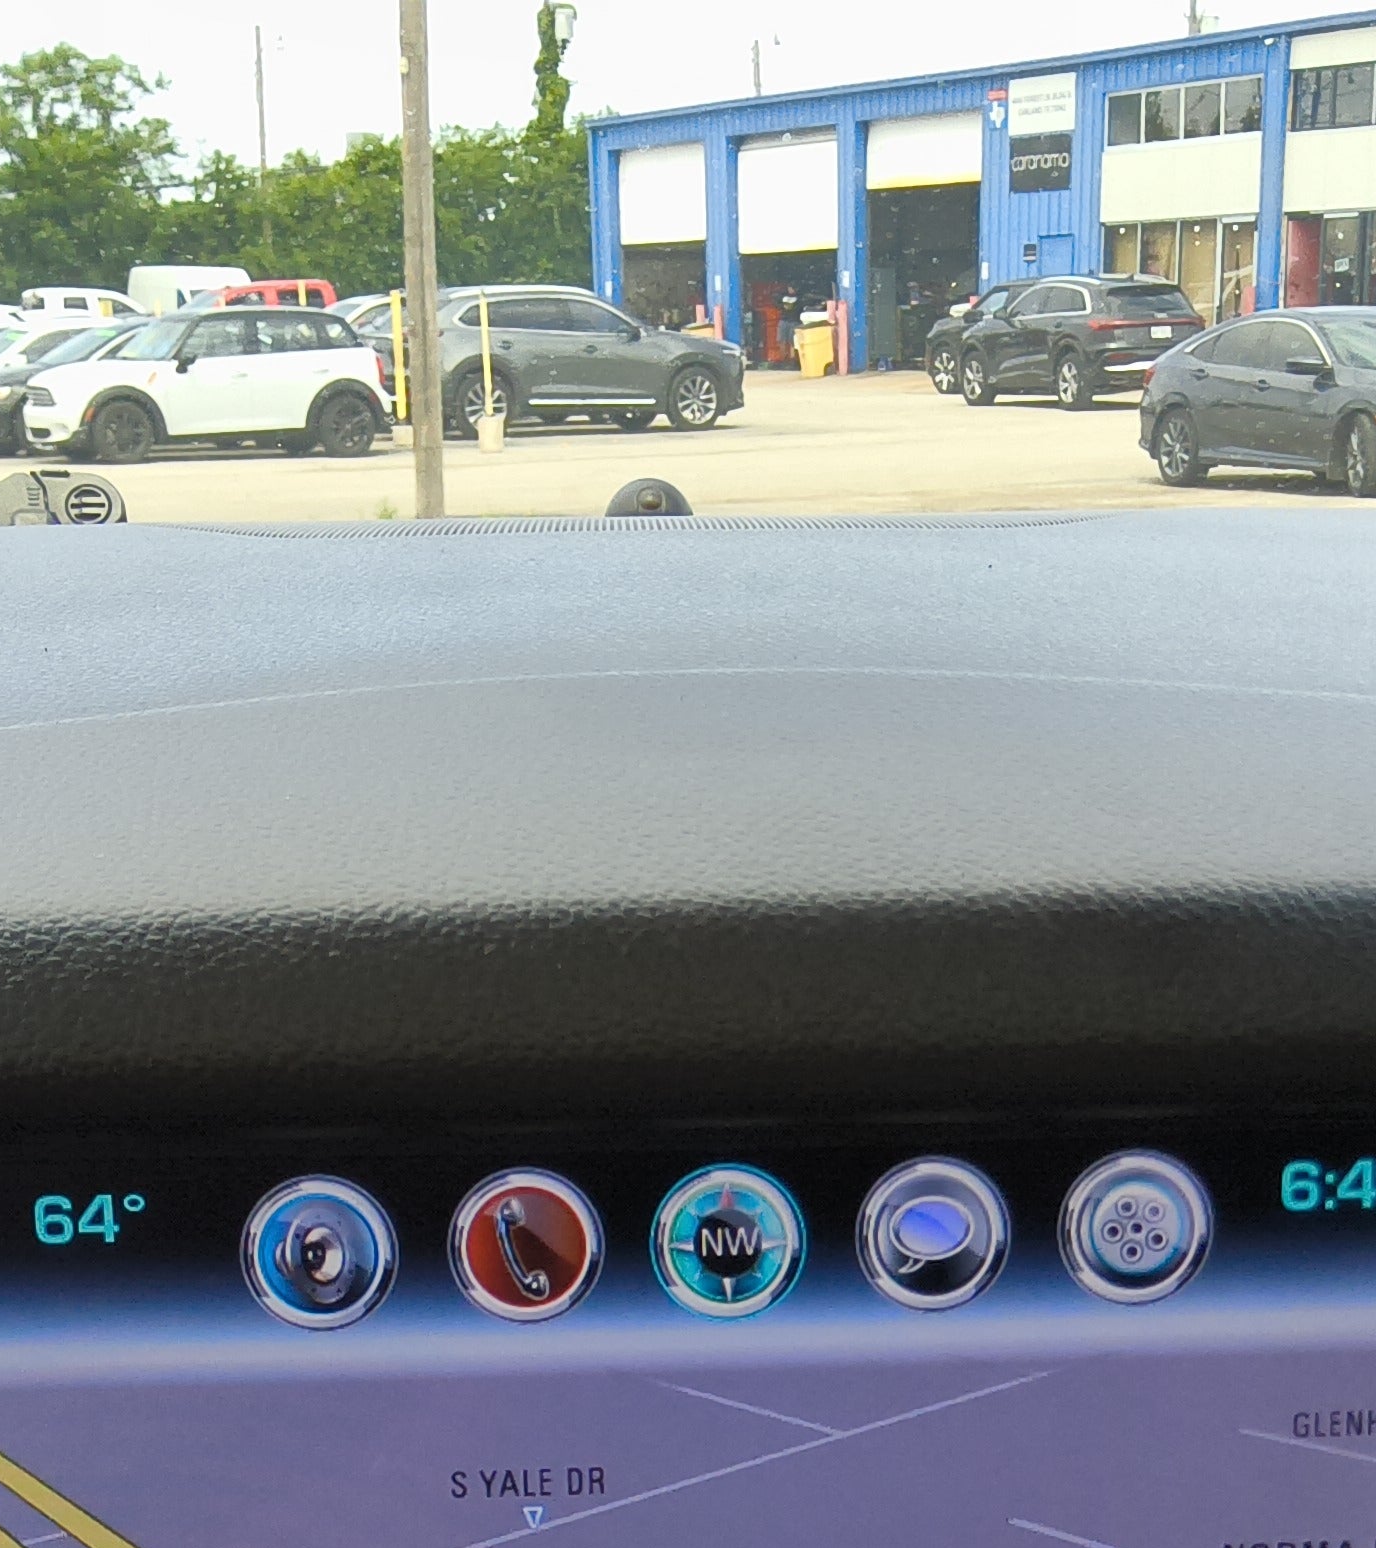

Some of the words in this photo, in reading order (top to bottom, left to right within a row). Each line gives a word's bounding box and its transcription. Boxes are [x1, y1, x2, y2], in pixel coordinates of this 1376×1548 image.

[34, 1194, 145, 1244] 64°
[701, 1226, 760, 1257] NW
[450, 1470, 468, 1499] S
[479, 1468, 552, 1498] YALE
[567, 1466, 605, 1496] DR
